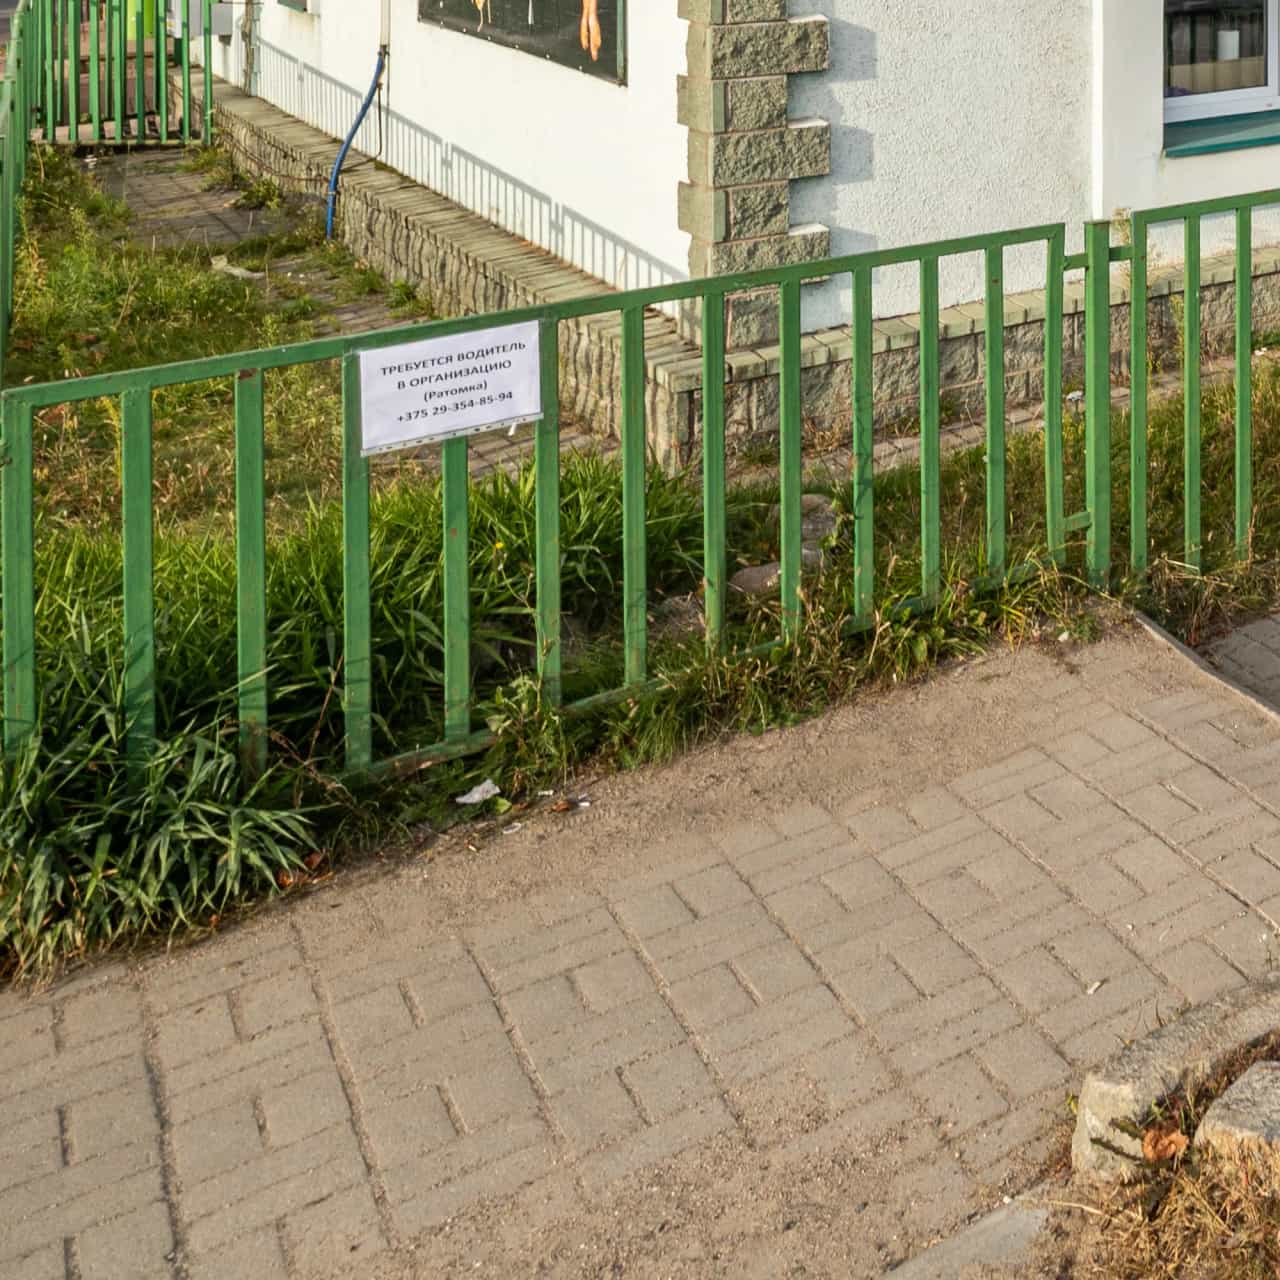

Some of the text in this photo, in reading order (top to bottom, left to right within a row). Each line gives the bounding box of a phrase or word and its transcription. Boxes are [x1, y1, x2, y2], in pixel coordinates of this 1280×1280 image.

[380, 341, 526, 376] ТРЕБУЕТСЯ ВОДИТЕЛЬ
[397, 359, 512, 390] В ОРГАНИЗАЦИЮ
[397, 391, 513, 422] +375 29-354-85-94
[423, 381, 488, 402] (Ратомка)
